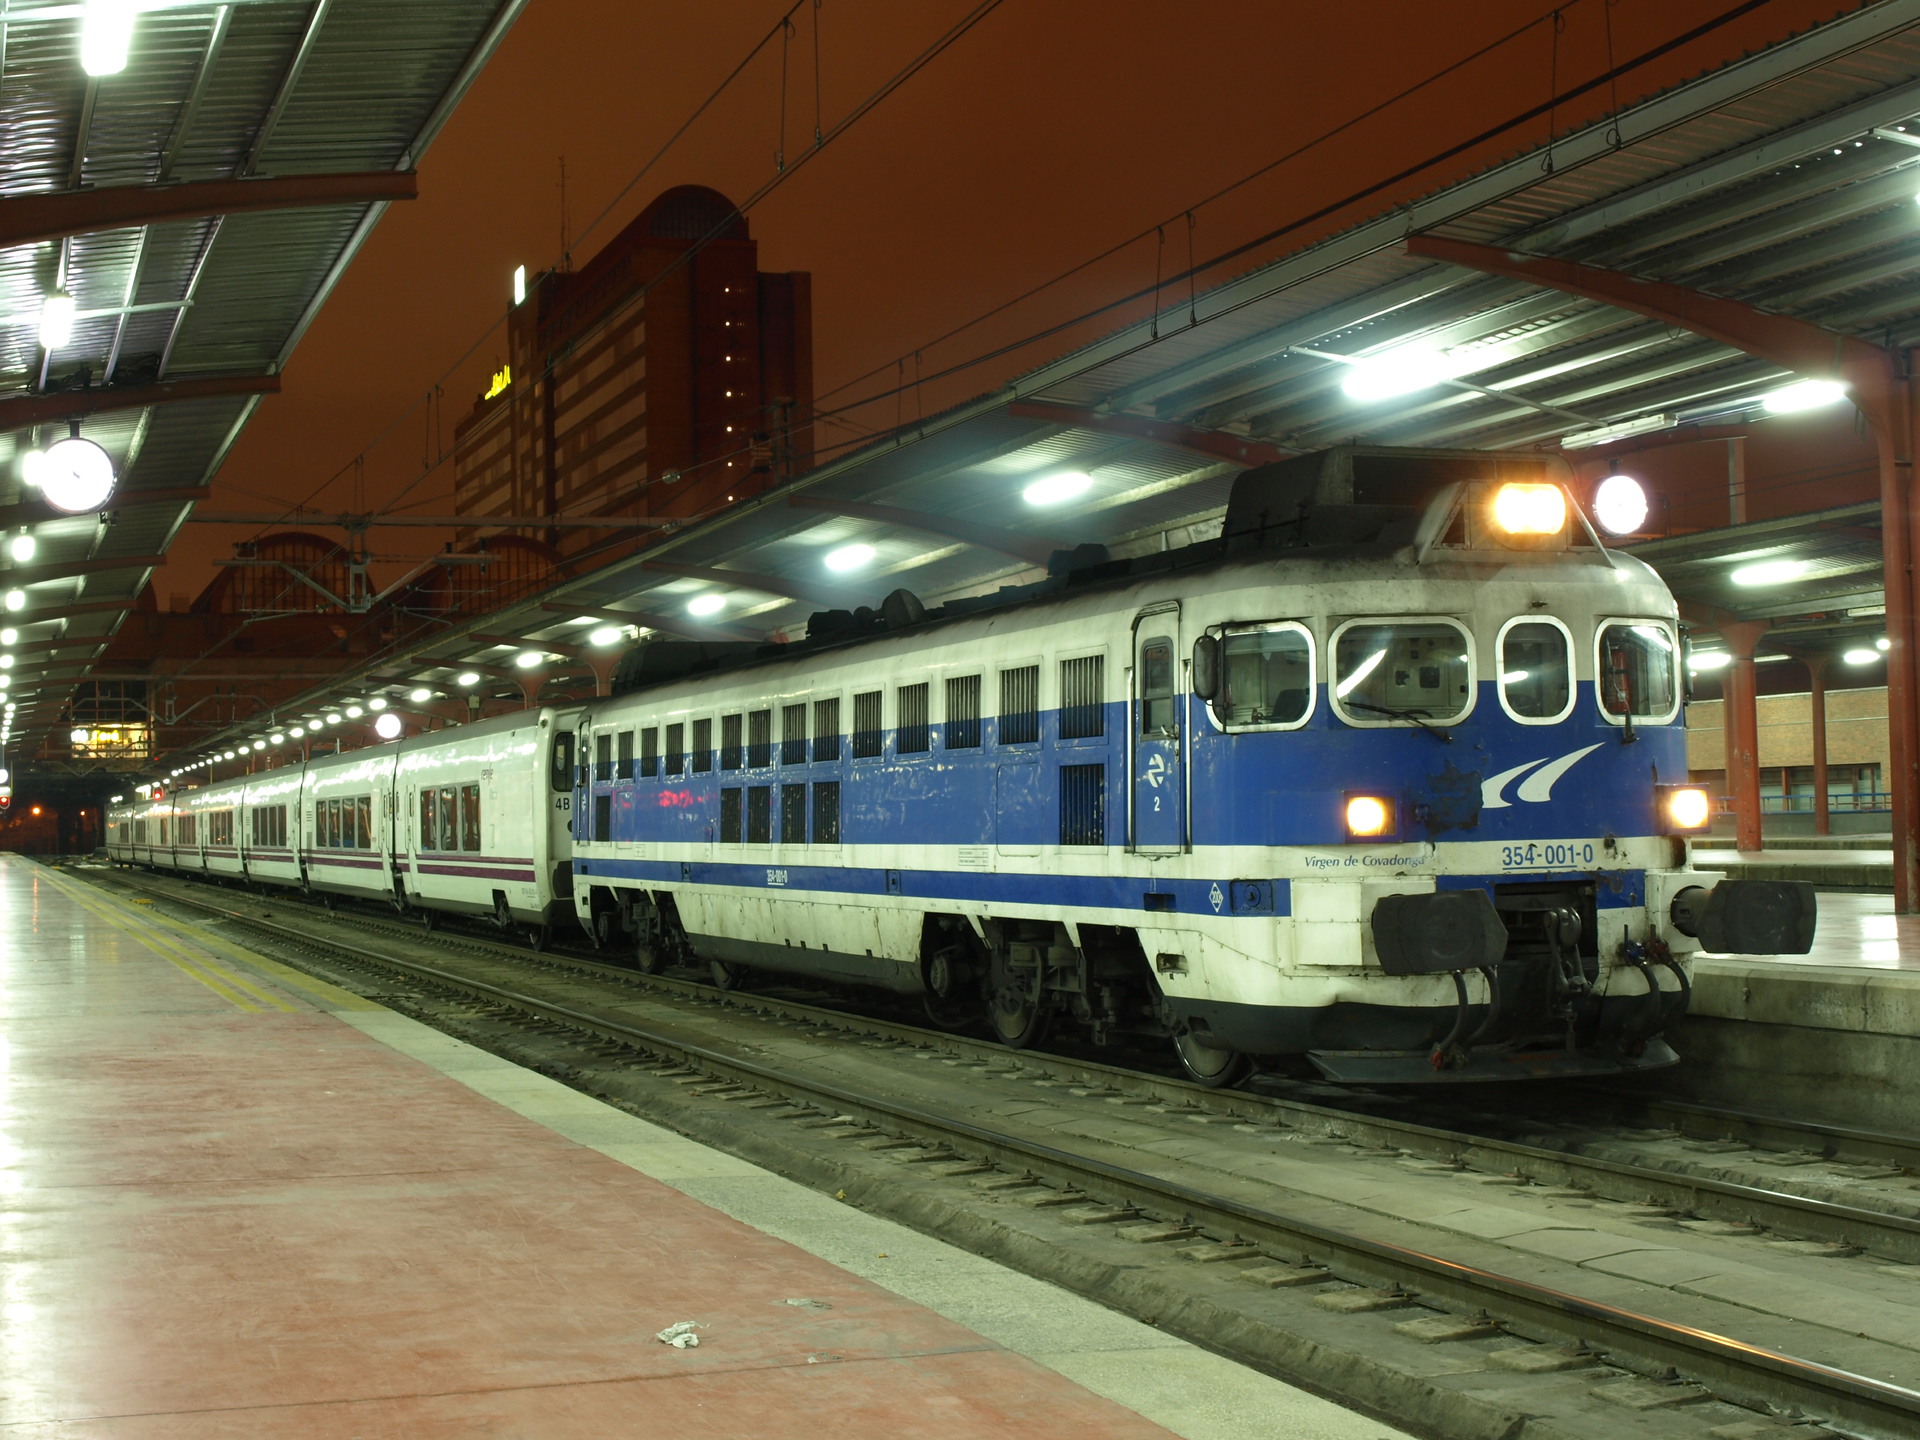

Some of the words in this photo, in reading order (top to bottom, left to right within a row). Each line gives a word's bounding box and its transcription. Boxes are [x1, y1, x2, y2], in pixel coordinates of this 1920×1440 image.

[555, 797, 570, 810] 4B
[1153, 795, 1160, 811] 2
[1305, 855, 1340, 869] Virgen
[1344, 854, 1359, 866] de
[1362, 853, 1425, 869] Covadonga
[1502, 843, 1593, 866] 354-001-0
